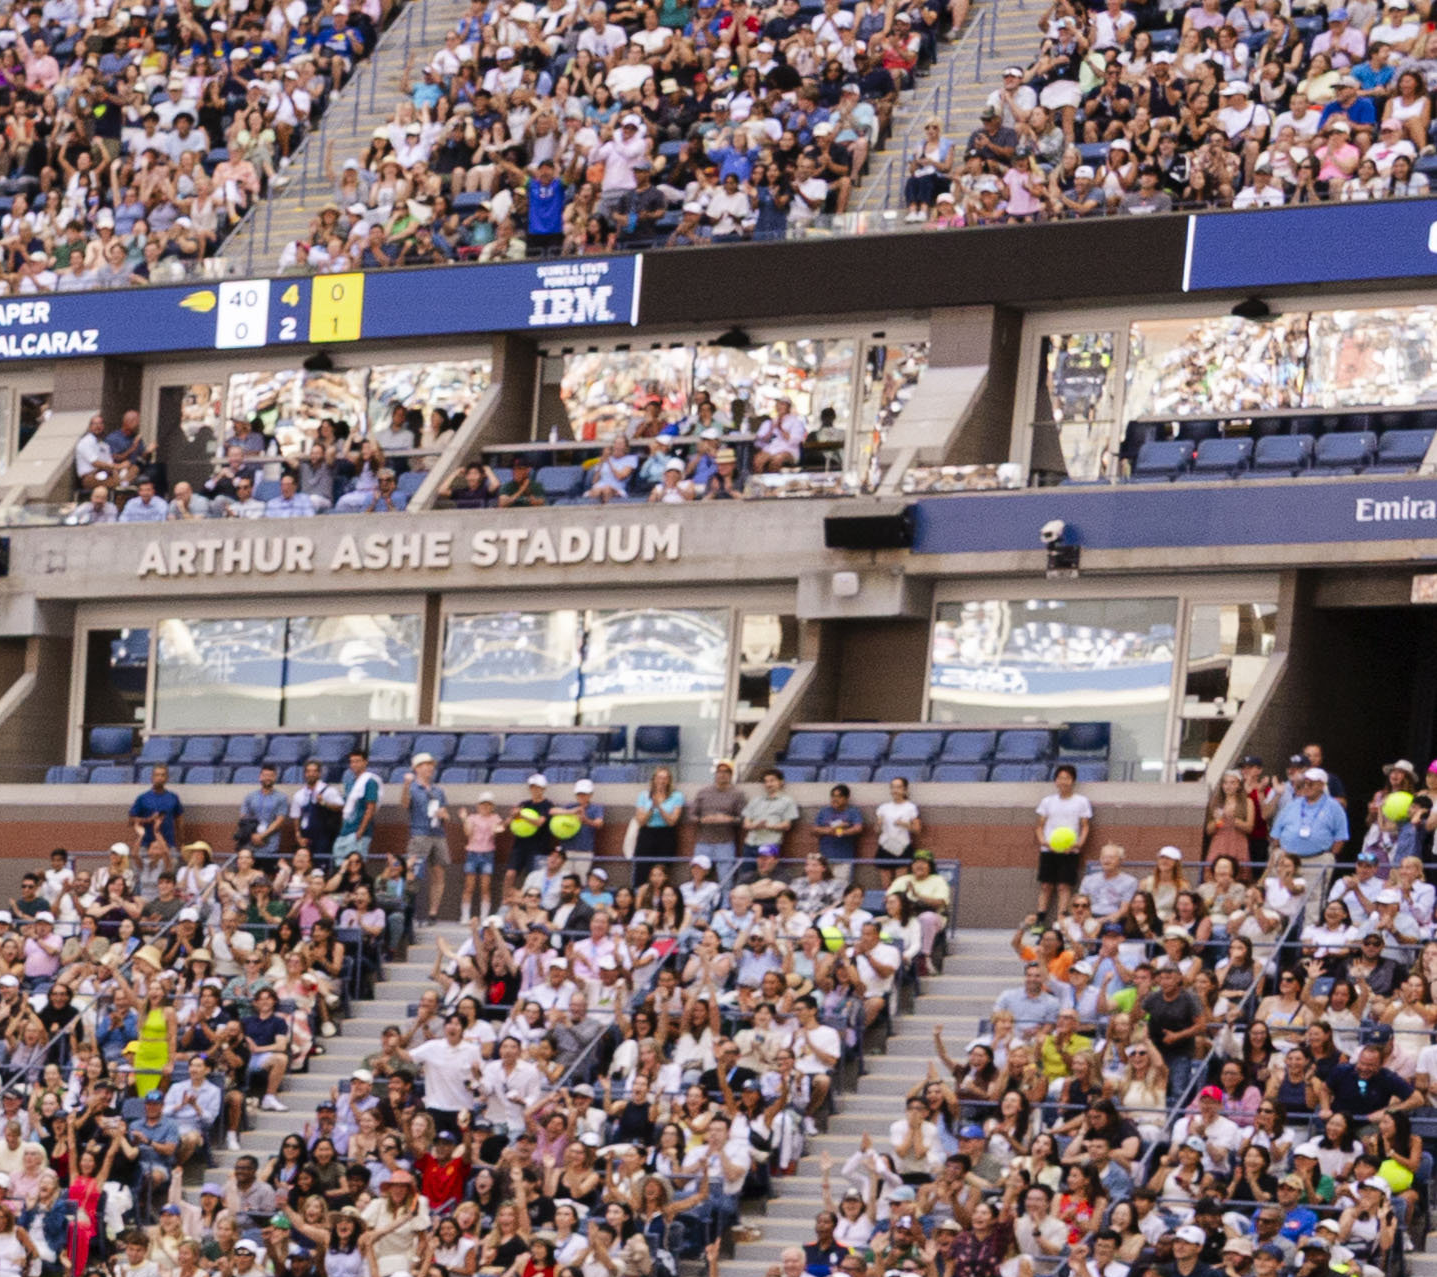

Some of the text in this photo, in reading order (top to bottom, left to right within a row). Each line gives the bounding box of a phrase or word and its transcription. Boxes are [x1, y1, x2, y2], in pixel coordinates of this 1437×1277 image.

[229, 284, 344, 309] 40 4 0
[529, 285, 615, 326] IBM
[234, 316, 341, 340] 0 2 1
[138, 522, 682, 576] ARTHUR ASHE STADIUM
